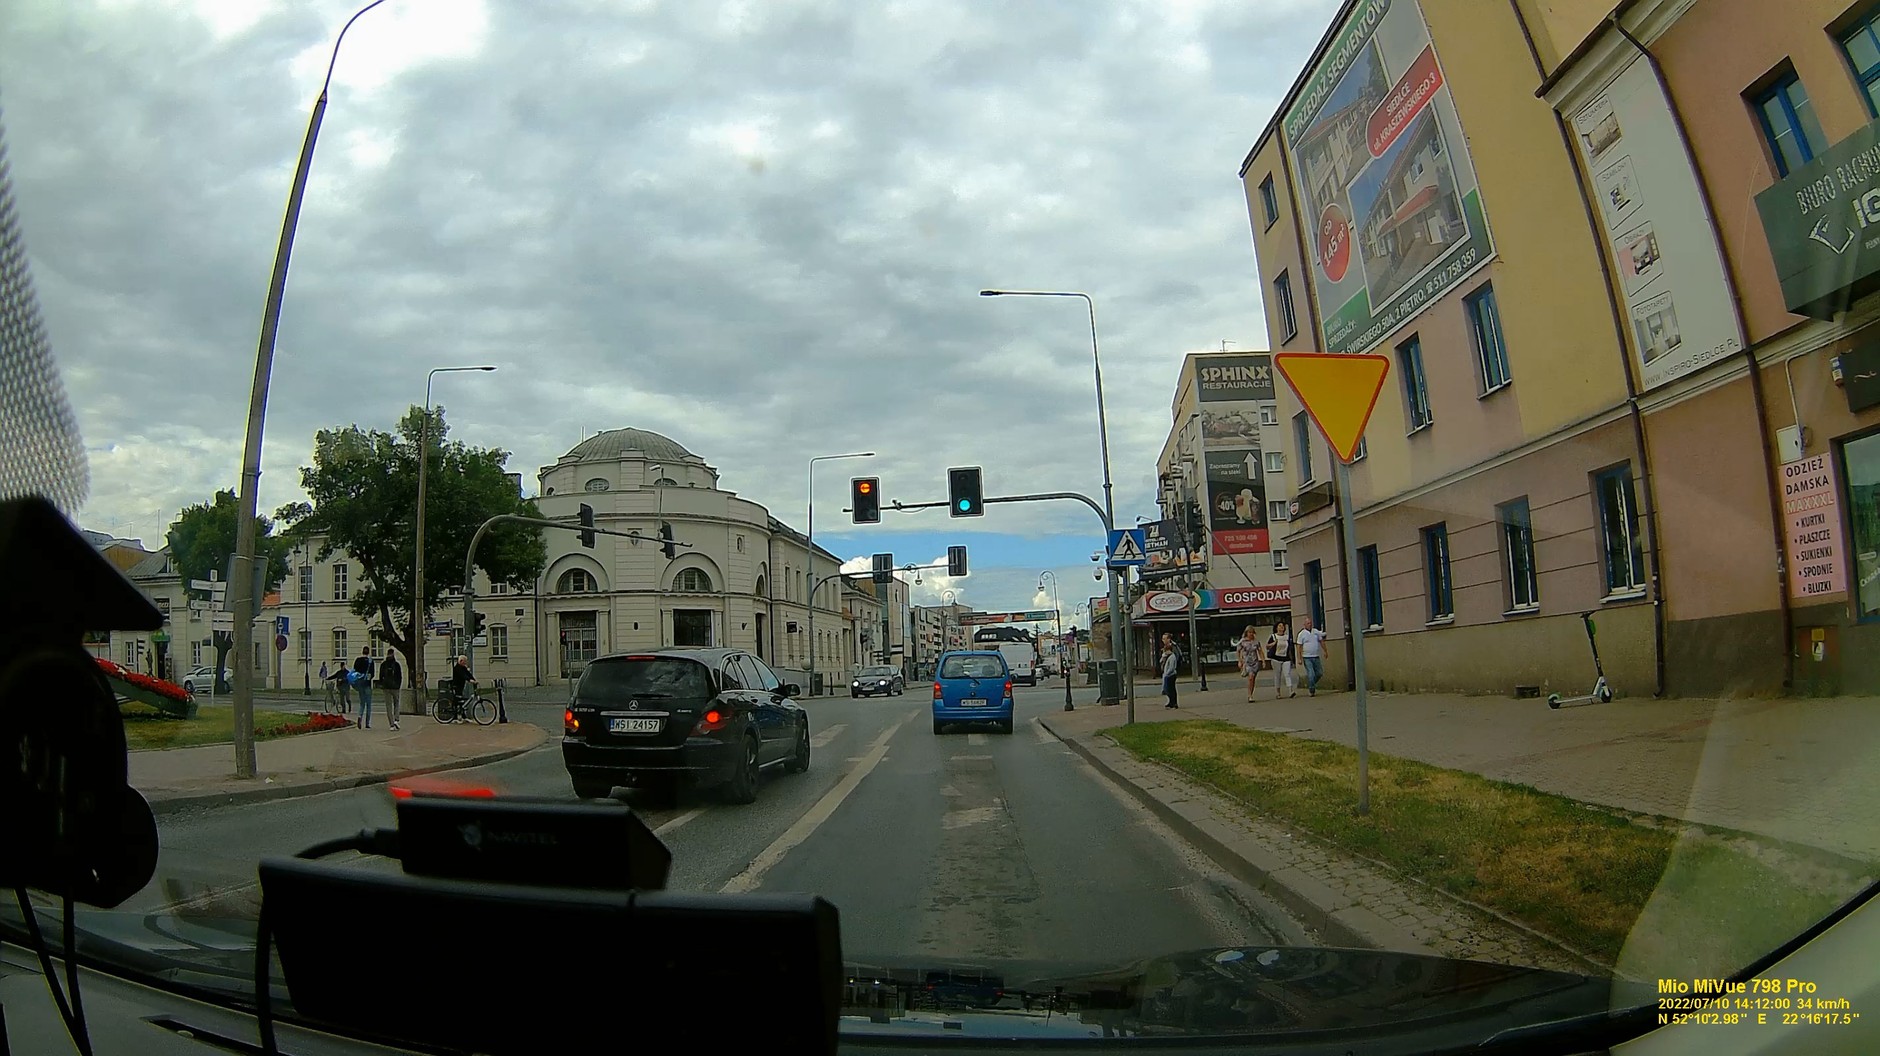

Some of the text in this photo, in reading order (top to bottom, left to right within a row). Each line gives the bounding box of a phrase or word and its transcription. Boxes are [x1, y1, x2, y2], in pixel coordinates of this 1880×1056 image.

[1289, 0, 1387, 141] SPRZEDAŻ SEGMENTÓW
[1379, 80, 1430, 142] KRASZEWSKIEGO
[1429, 72, 1436, 84] 3
[1386, 81, 1411, 117] SIEDLCE
[1796, 174, 1836, 215] BIURO
[1324, 219, 1333, 236] OD
[1323, 236, 1339, 267] 145
[1394, 307, 1401, 319] 2
[1399, 289, 1427, 315] PIĘTRO,
[1434, 275, 1448, 291] 511
[1447, 260, 1462, 280] 758
[1460, 247, 1476, 267] 359
[1201, 365, 1269, 381] SPHINX
[1202, 380, 1271, 390] RESTAURACJE
[1786, 455, 1824, 478] ODZIEŻ
[1786, 475, 1829, 495] DAMSKA
[1786, 491, 1834, 515] MAXXXL
[1801, 513, 1825, 528] KURTKI
[1799, 529, 1831, 545] PŁASZCZE
[1801, 546, 1833, 561] SUKIENKI
[1803, 563, 1833, 578] SPODNIE
[1808, 580, 1832, 594] BLUZKI
[614, 719, 659, 731] WSI 24157
